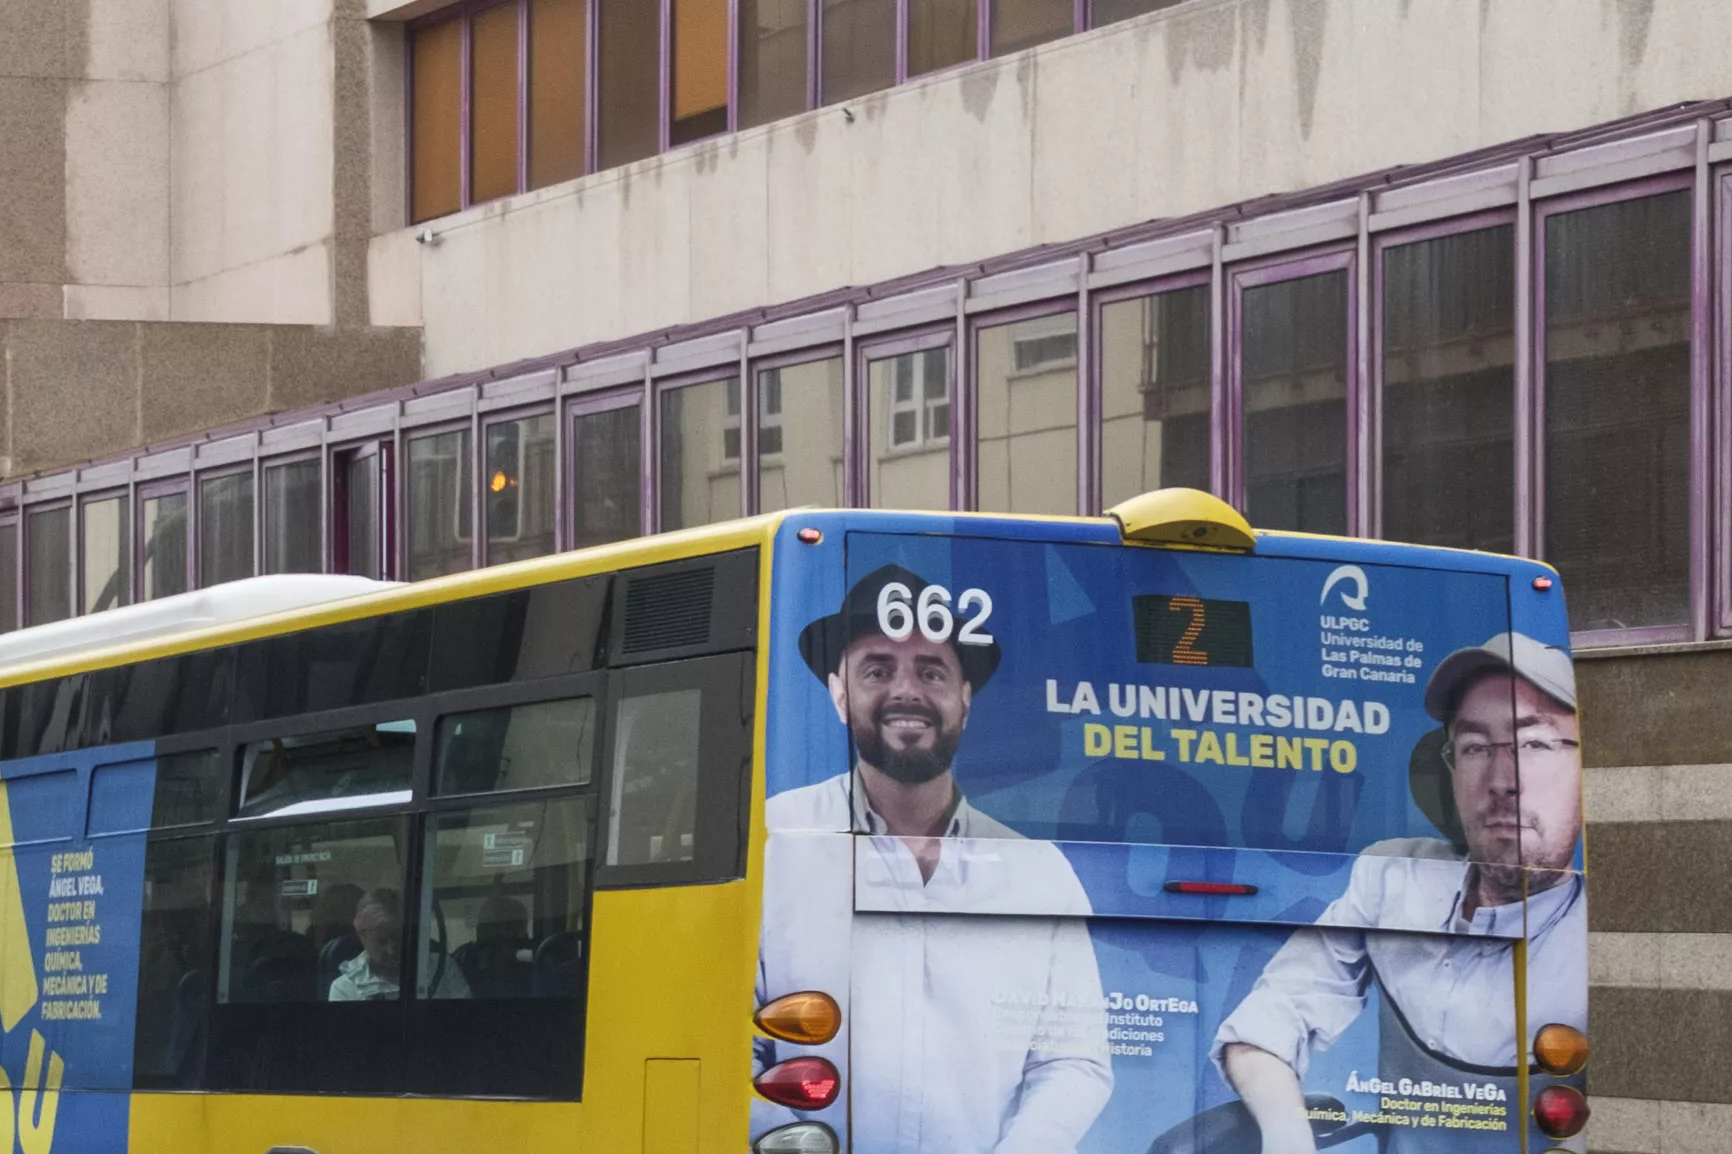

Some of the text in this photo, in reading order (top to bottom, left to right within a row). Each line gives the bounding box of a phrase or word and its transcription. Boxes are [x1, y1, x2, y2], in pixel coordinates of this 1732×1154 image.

[876, 581, 994, 646] 662
[1320, 615, 1370, 631] ULPGC
[1169, 597, 1208, 665] 2
[1320, 631, 1424, 652] Universidad de
[1321, 647, 1422, 668] Las Palmas de
[1321, 663, 1416, 684] Gran Canaria
[1044, 678, 1392, 736] LA UNIVERSIDAD
[1083, 722, 1359, 775] DEL TALENTO
[51, 846, 94, 874] SE FORMÓ
[48, 873, 105, 899] ÁNGEL VEGA,
[47, 900, 96, 923] DOCTOR EN
[45, 920, 101, 947] INGENIERÍAS
[42, 971, 89, 996] MECÁNICA
[95, 974, 108, 994] DE
[1105, 1012, 1164, 1028] Instituto
[1380, 1096, 1507, 1117] Doctor en Ingenierías
[1352, 1109, 1410, 1126] Mecánica
[1411, 1115, 1419, 1129] y
[1420, 1114, 1436, 1127] de
[1438, 1115, 1507, 1132] Fabricación
